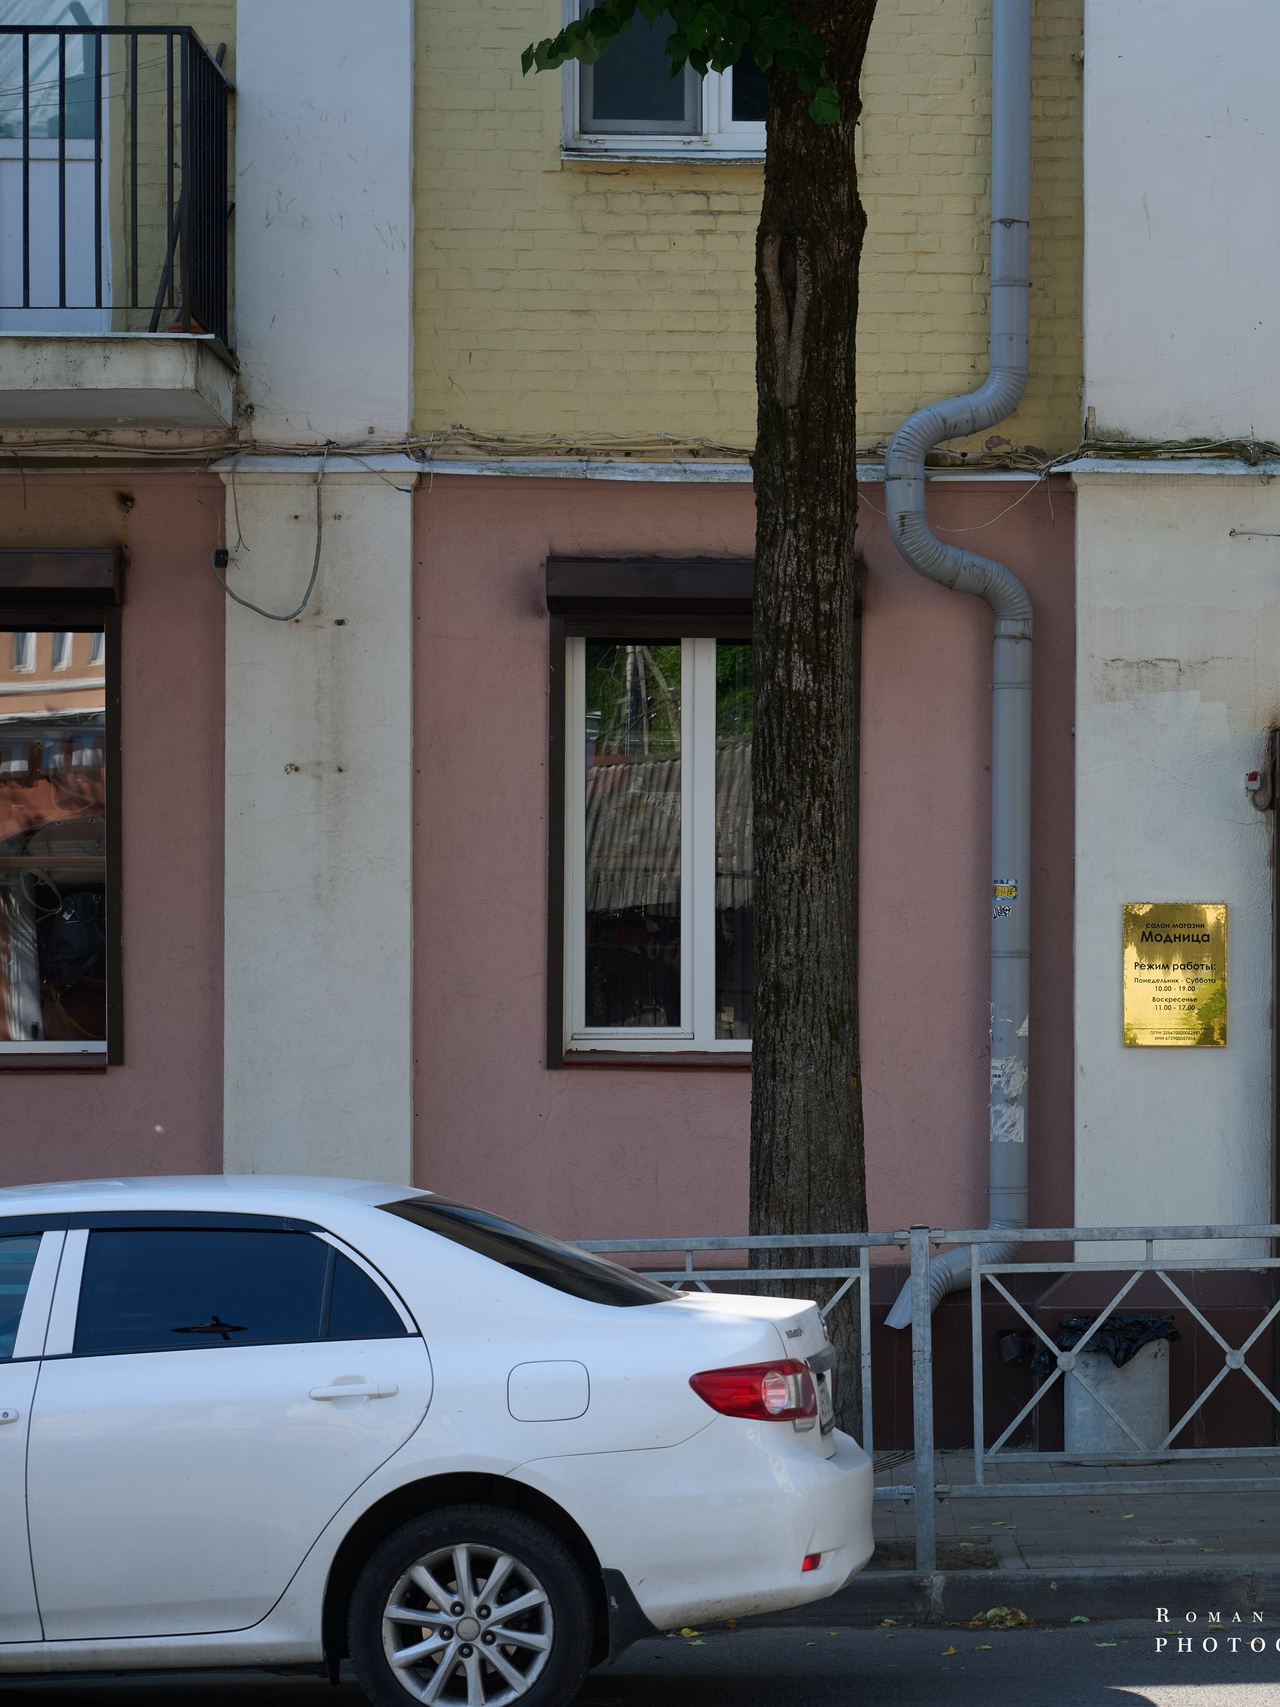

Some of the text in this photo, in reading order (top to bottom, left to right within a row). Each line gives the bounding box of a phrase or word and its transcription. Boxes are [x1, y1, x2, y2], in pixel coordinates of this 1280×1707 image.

[1140, 931, 1210, 944] Модница
[1134, 962, 1216, 972] Режим работы:
